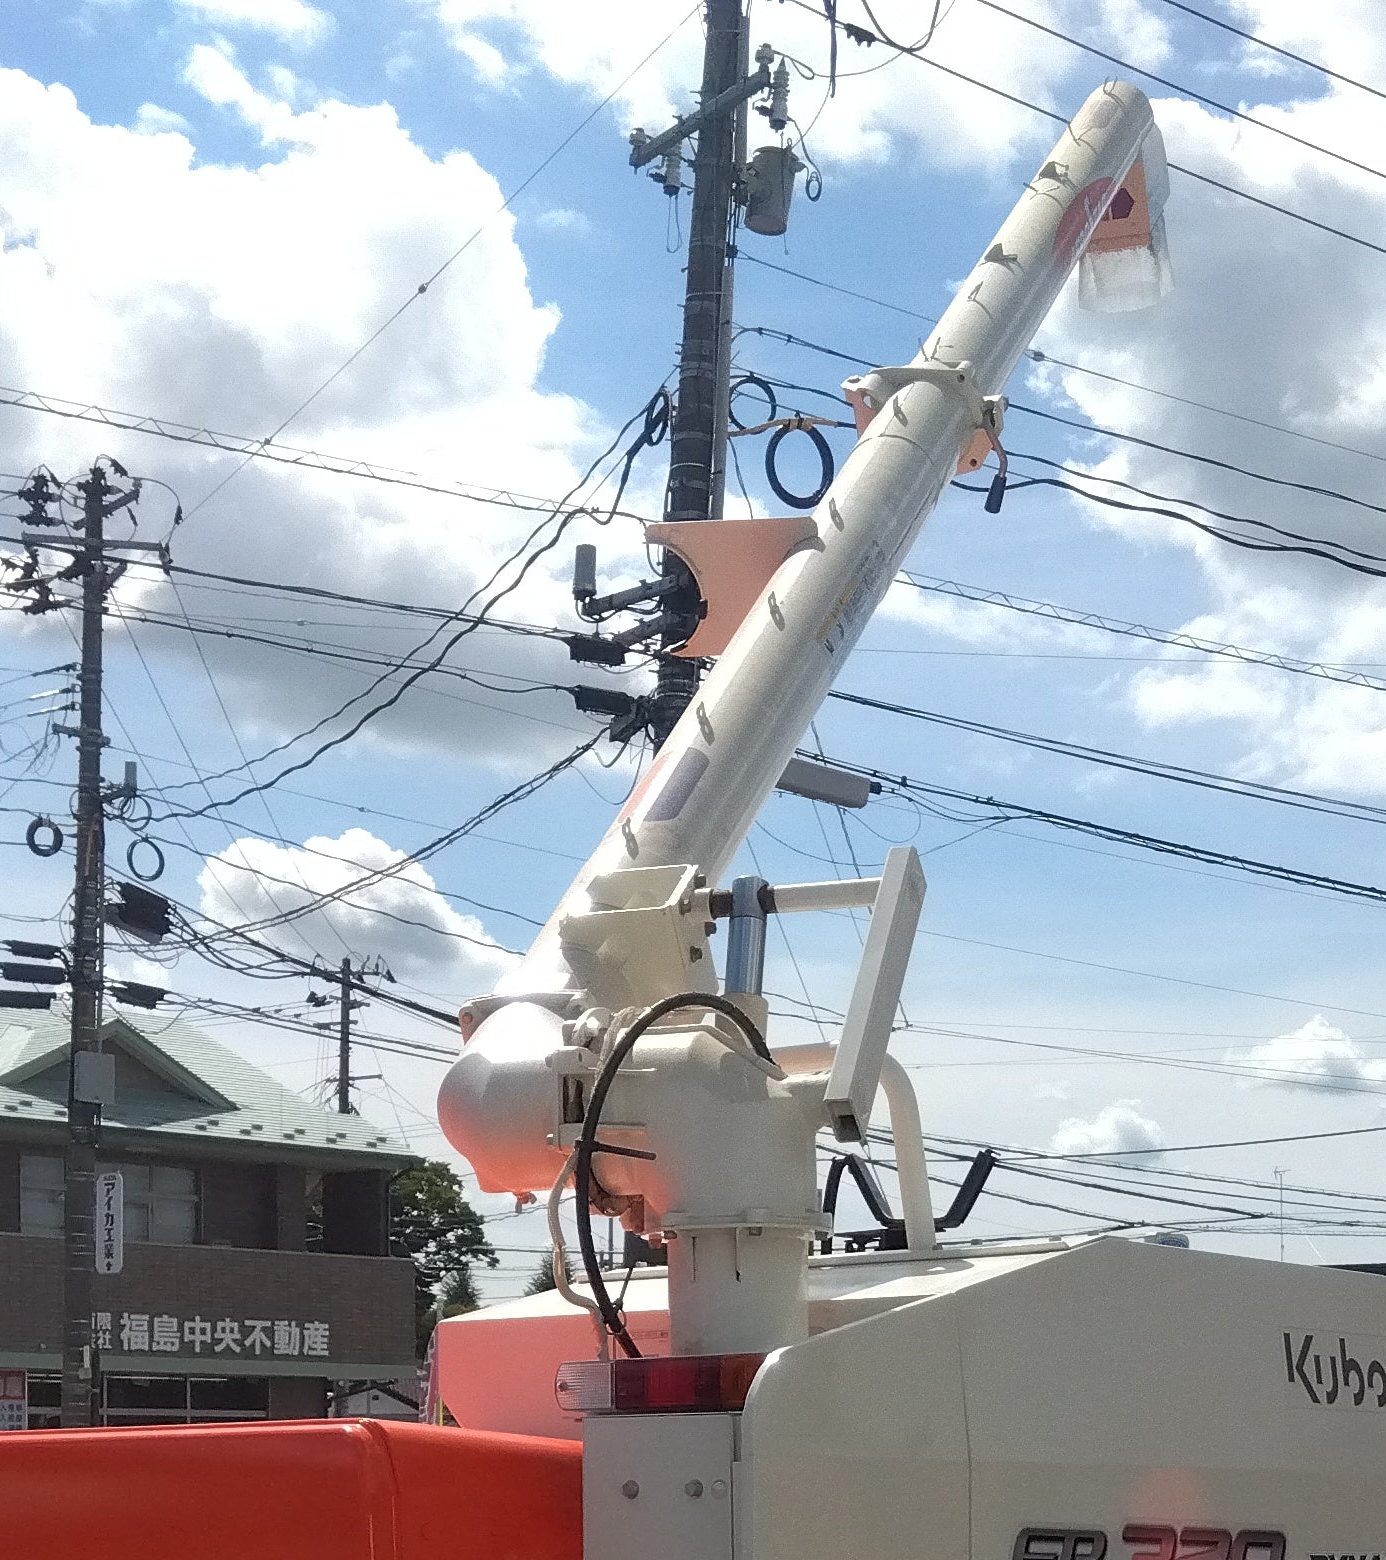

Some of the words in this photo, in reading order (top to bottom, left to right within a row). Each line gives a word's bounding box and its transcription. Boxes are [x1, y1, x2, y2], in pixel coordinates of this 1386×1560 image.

[103, 1181, 116, 1260] アイカ工業
[119, 1312, 331, 1357] 福島中央不動産
